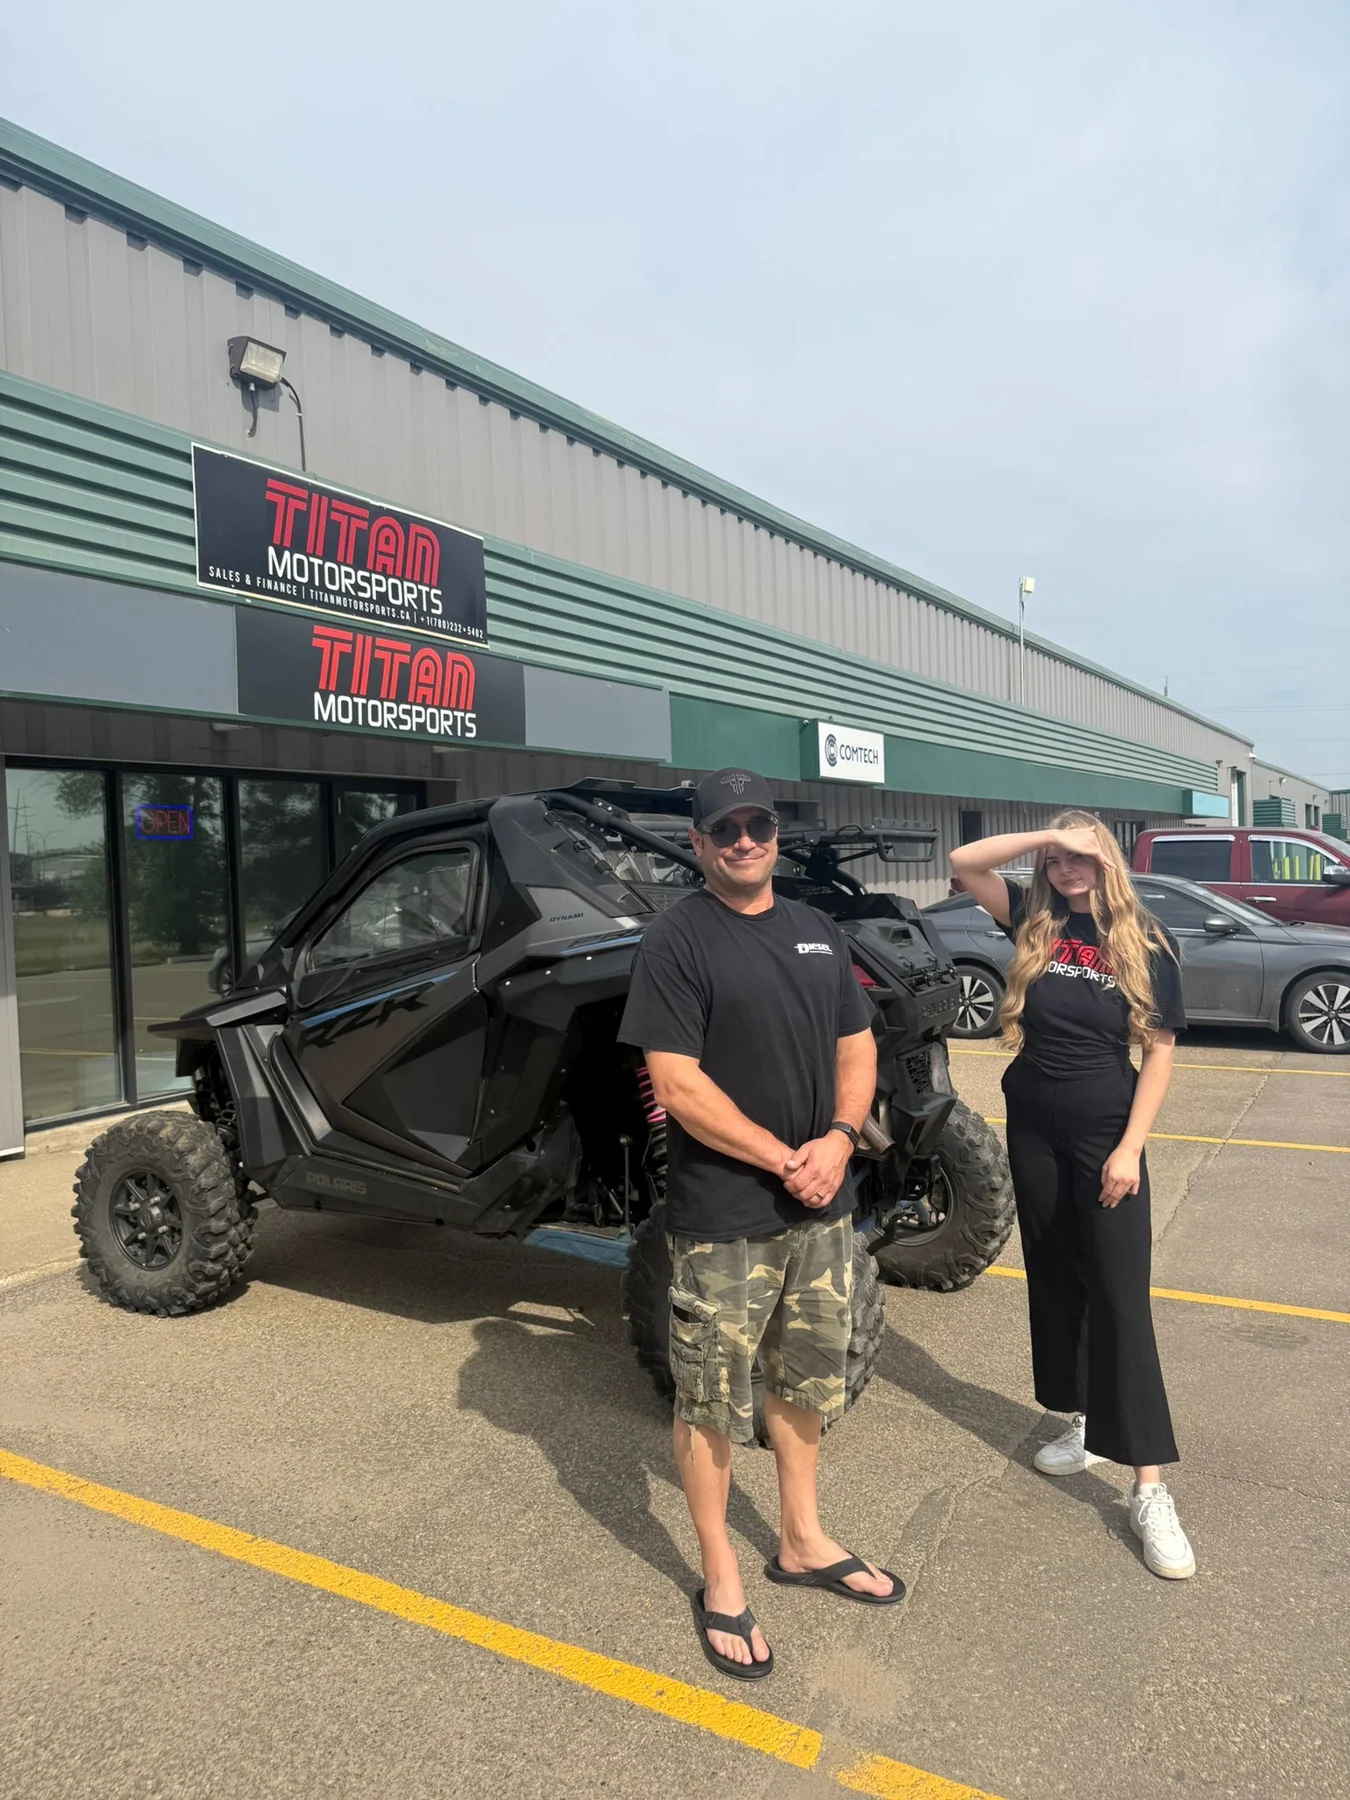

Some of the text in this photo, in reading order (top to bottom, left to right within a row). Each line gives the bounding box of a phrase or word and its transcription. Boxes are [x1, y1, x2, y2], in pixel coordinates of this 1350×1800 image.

[265, 477, 441, 586] TITAN
[208, 565, 241, 583] SALES
[245, 573, 252, 586] &
[256, 577, 298, 596] FINANCE
[309, 589, 411, 621] TITANMOTORSPORTS.CA
[267, 545, 443, 615] MOTORSPORTS
[311, 624, 476, 711] TITAN
[313, 691, 477, 738] MOTORSPORTS
[839, 744, 879, 765] COMTECH
[140, 809, 190, 835] OPEN
[1048, 960, 1117, 989] ORSPORTS
[298, 981, 436, 1059] RZR
[305, 1171, 368, 1195] POLARIS
